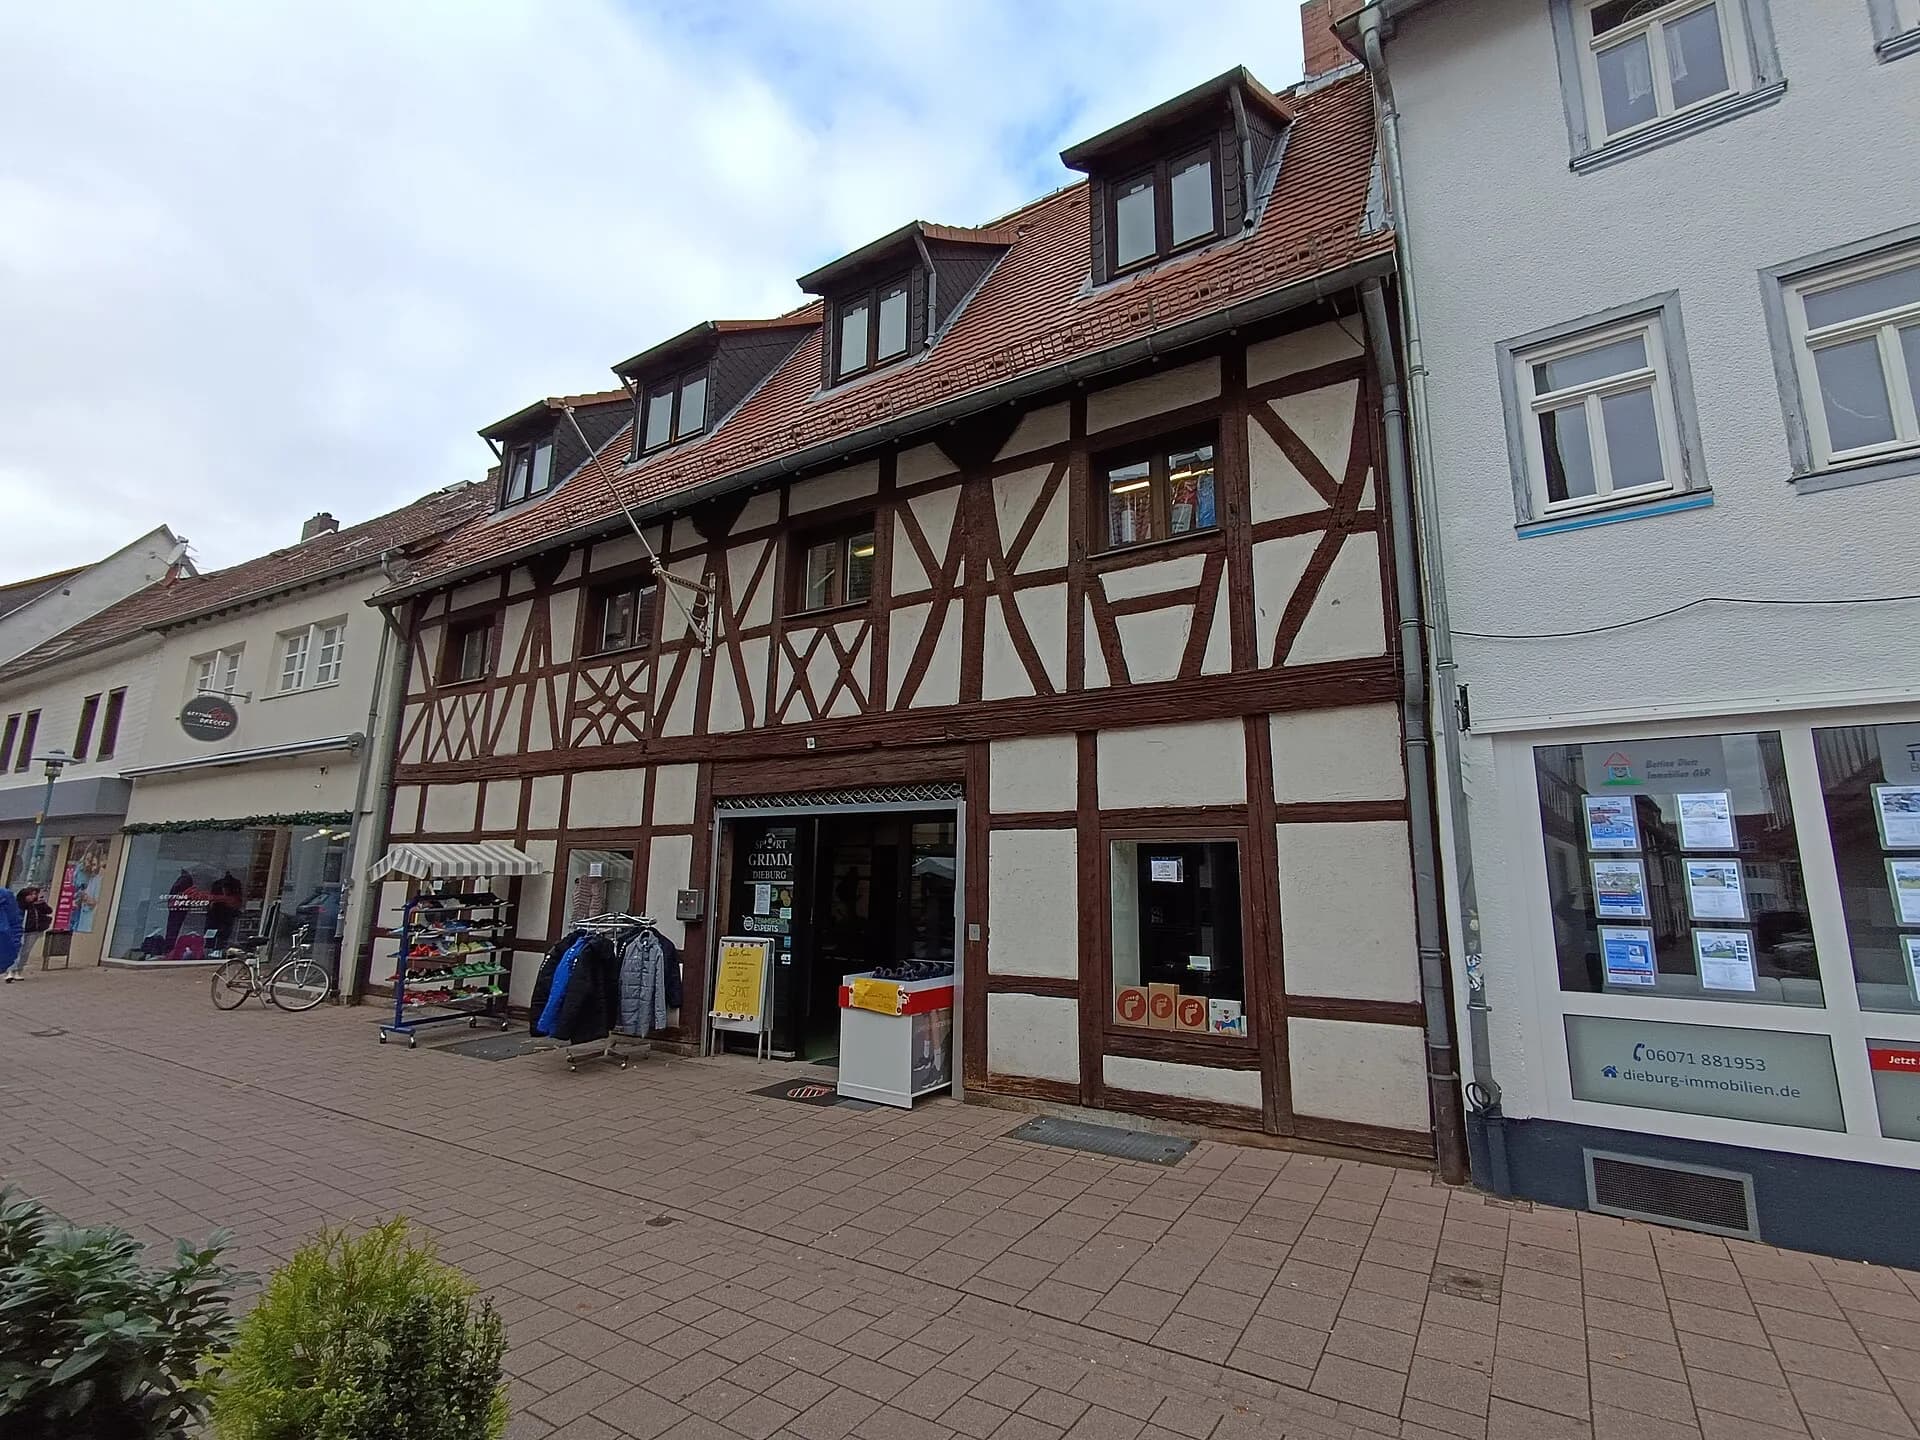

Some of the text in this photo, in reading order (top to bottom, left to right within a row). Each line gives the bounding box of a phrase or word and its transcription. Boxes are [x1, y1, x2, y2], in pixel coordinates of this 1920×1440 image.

[1692, 767, 1711, 777] GbR
[748, 852, 793, 866] GRIMM
[752, 870, 787, 880] DIEBURG
[1646, 1049, 1766, 1072] 06071 881953
[1888, 1055, 1917, 1065] Jetzt
[1623, 1069, 1801, 1098] dieburg-immobilien.de
